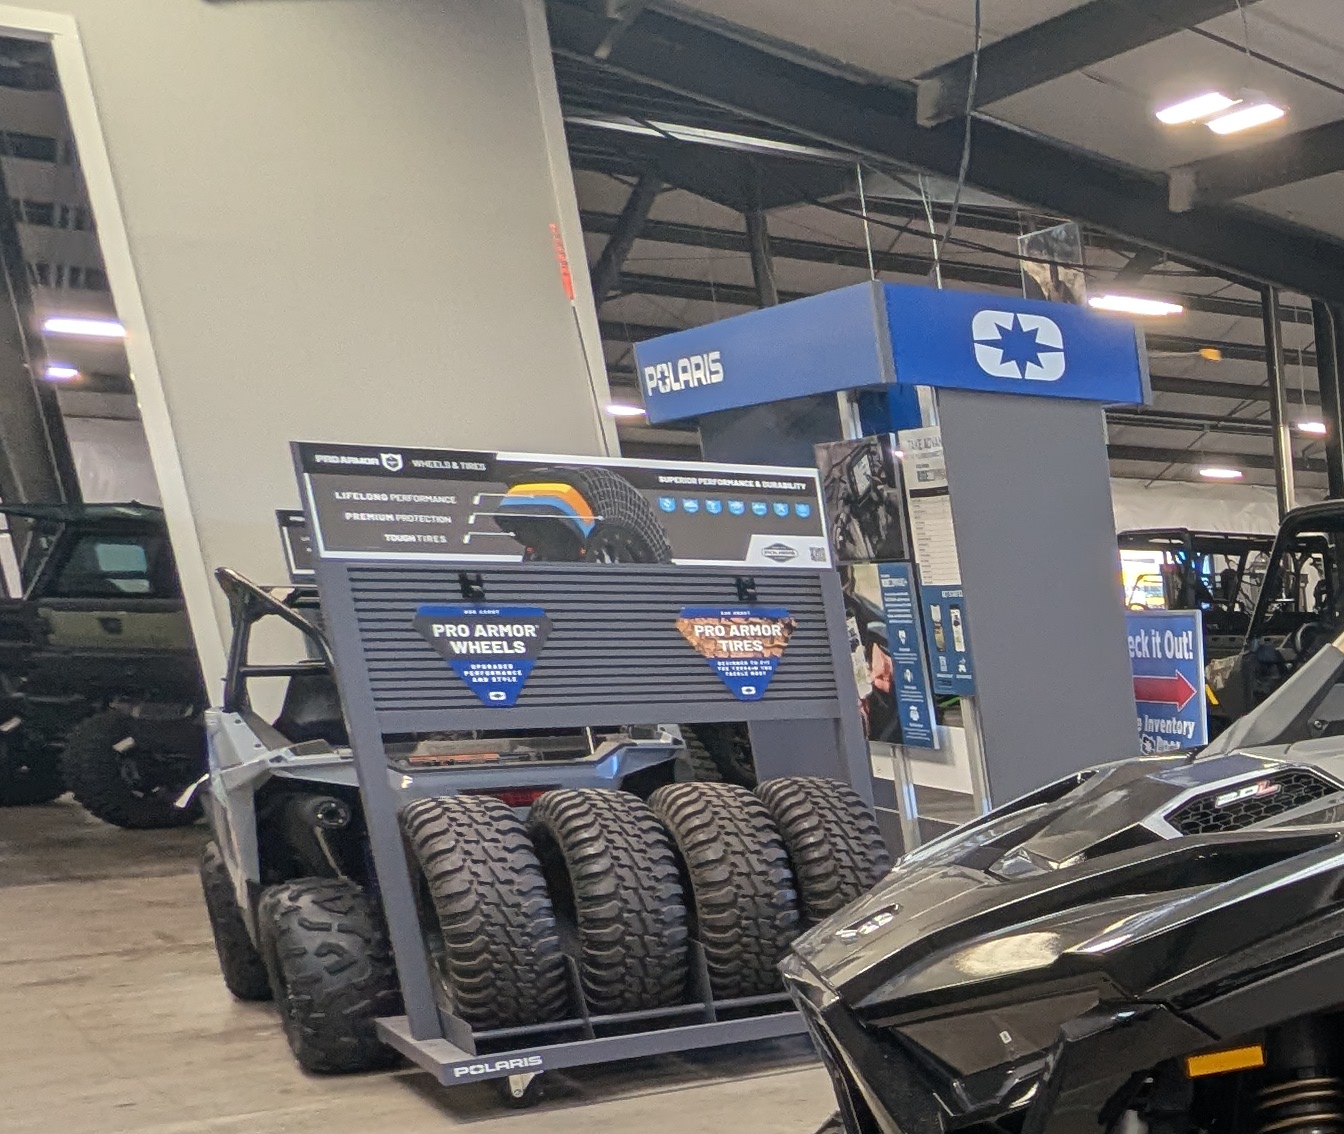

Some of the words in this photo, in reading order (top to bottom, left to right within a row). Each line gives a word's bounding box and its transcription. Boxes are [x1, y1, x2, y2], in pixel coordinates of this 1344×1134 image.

[644, 351, 724, 396] POLARIS
[412, 459, 451, 469] WHEELS
[460, 462, 486, 471] TIRES
[658, 475, 697, 485] SUPERIOR
[698, 477, 754, 488] PERFORMANCE
[762, 480, 806, 490] DURABILITY
[335, 491, 388, 502] LIFELONG
[390, 494, 457, 504] PERFORMANCE
[345, 512, 395, 522] PREMIUM
[396, 514, 452, 524] PROTECTION
[384, 533, 416, 542] TOUGH
[416, 534, 447, 543] TIRES
[432, 624, 470, 637] PRO
[474, 624, 538, 637] ARMOR
[694, 625, 725, 637] PRO
[730, 624, 782, 637] ARMOR
[450, 640, 526, 654] WHEELS
[717, 639, 764, 652] TIRES
[1127, 629, 1150, 658] eck
[1151, 629, 1162, 659] it
[1164, 630, 1194, 660] Out!
[1144, 715, 1195, 738] Inventory
[453, 1056, 543, 1078] POLARIS
